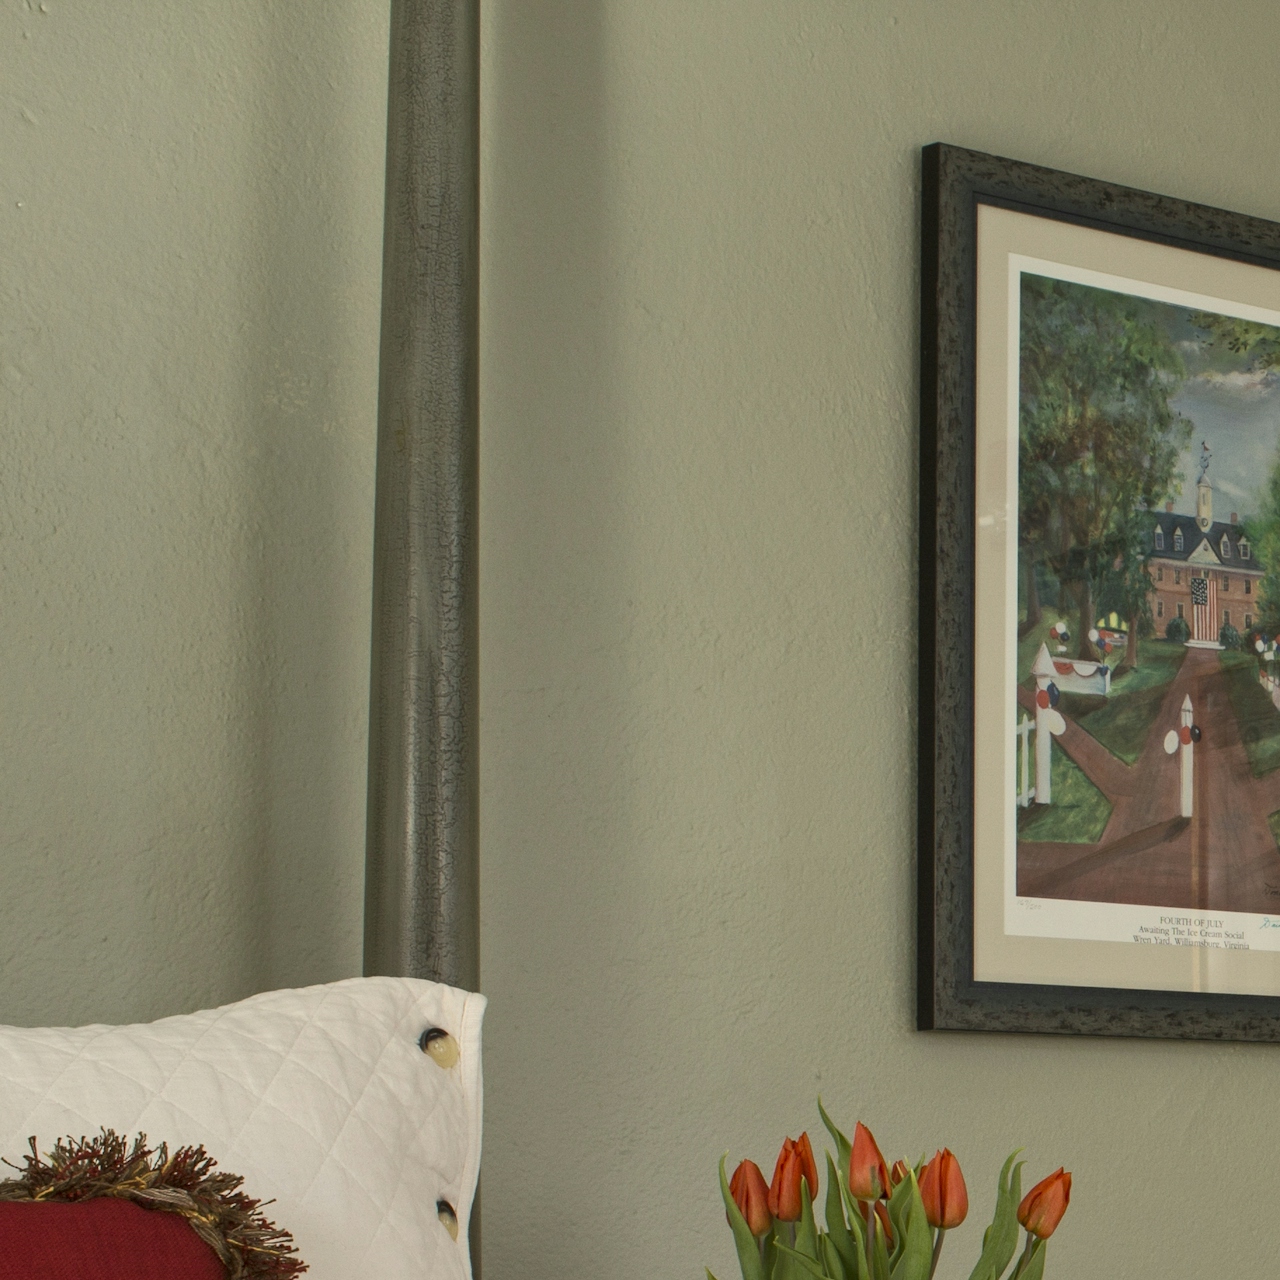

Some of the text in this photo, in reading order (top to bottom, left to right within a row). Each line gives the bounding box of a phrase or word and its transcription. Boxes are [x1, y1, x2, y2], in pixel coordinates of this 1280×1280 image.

[1160, 916, 1224, 929] FOURTH OF JULY
[1138, 925, 1244, 939] Awaiting The Ice Cream Social
[1133, 935, 1151, 944] Wren
[1223, 941, 1250, 950] Virginia
